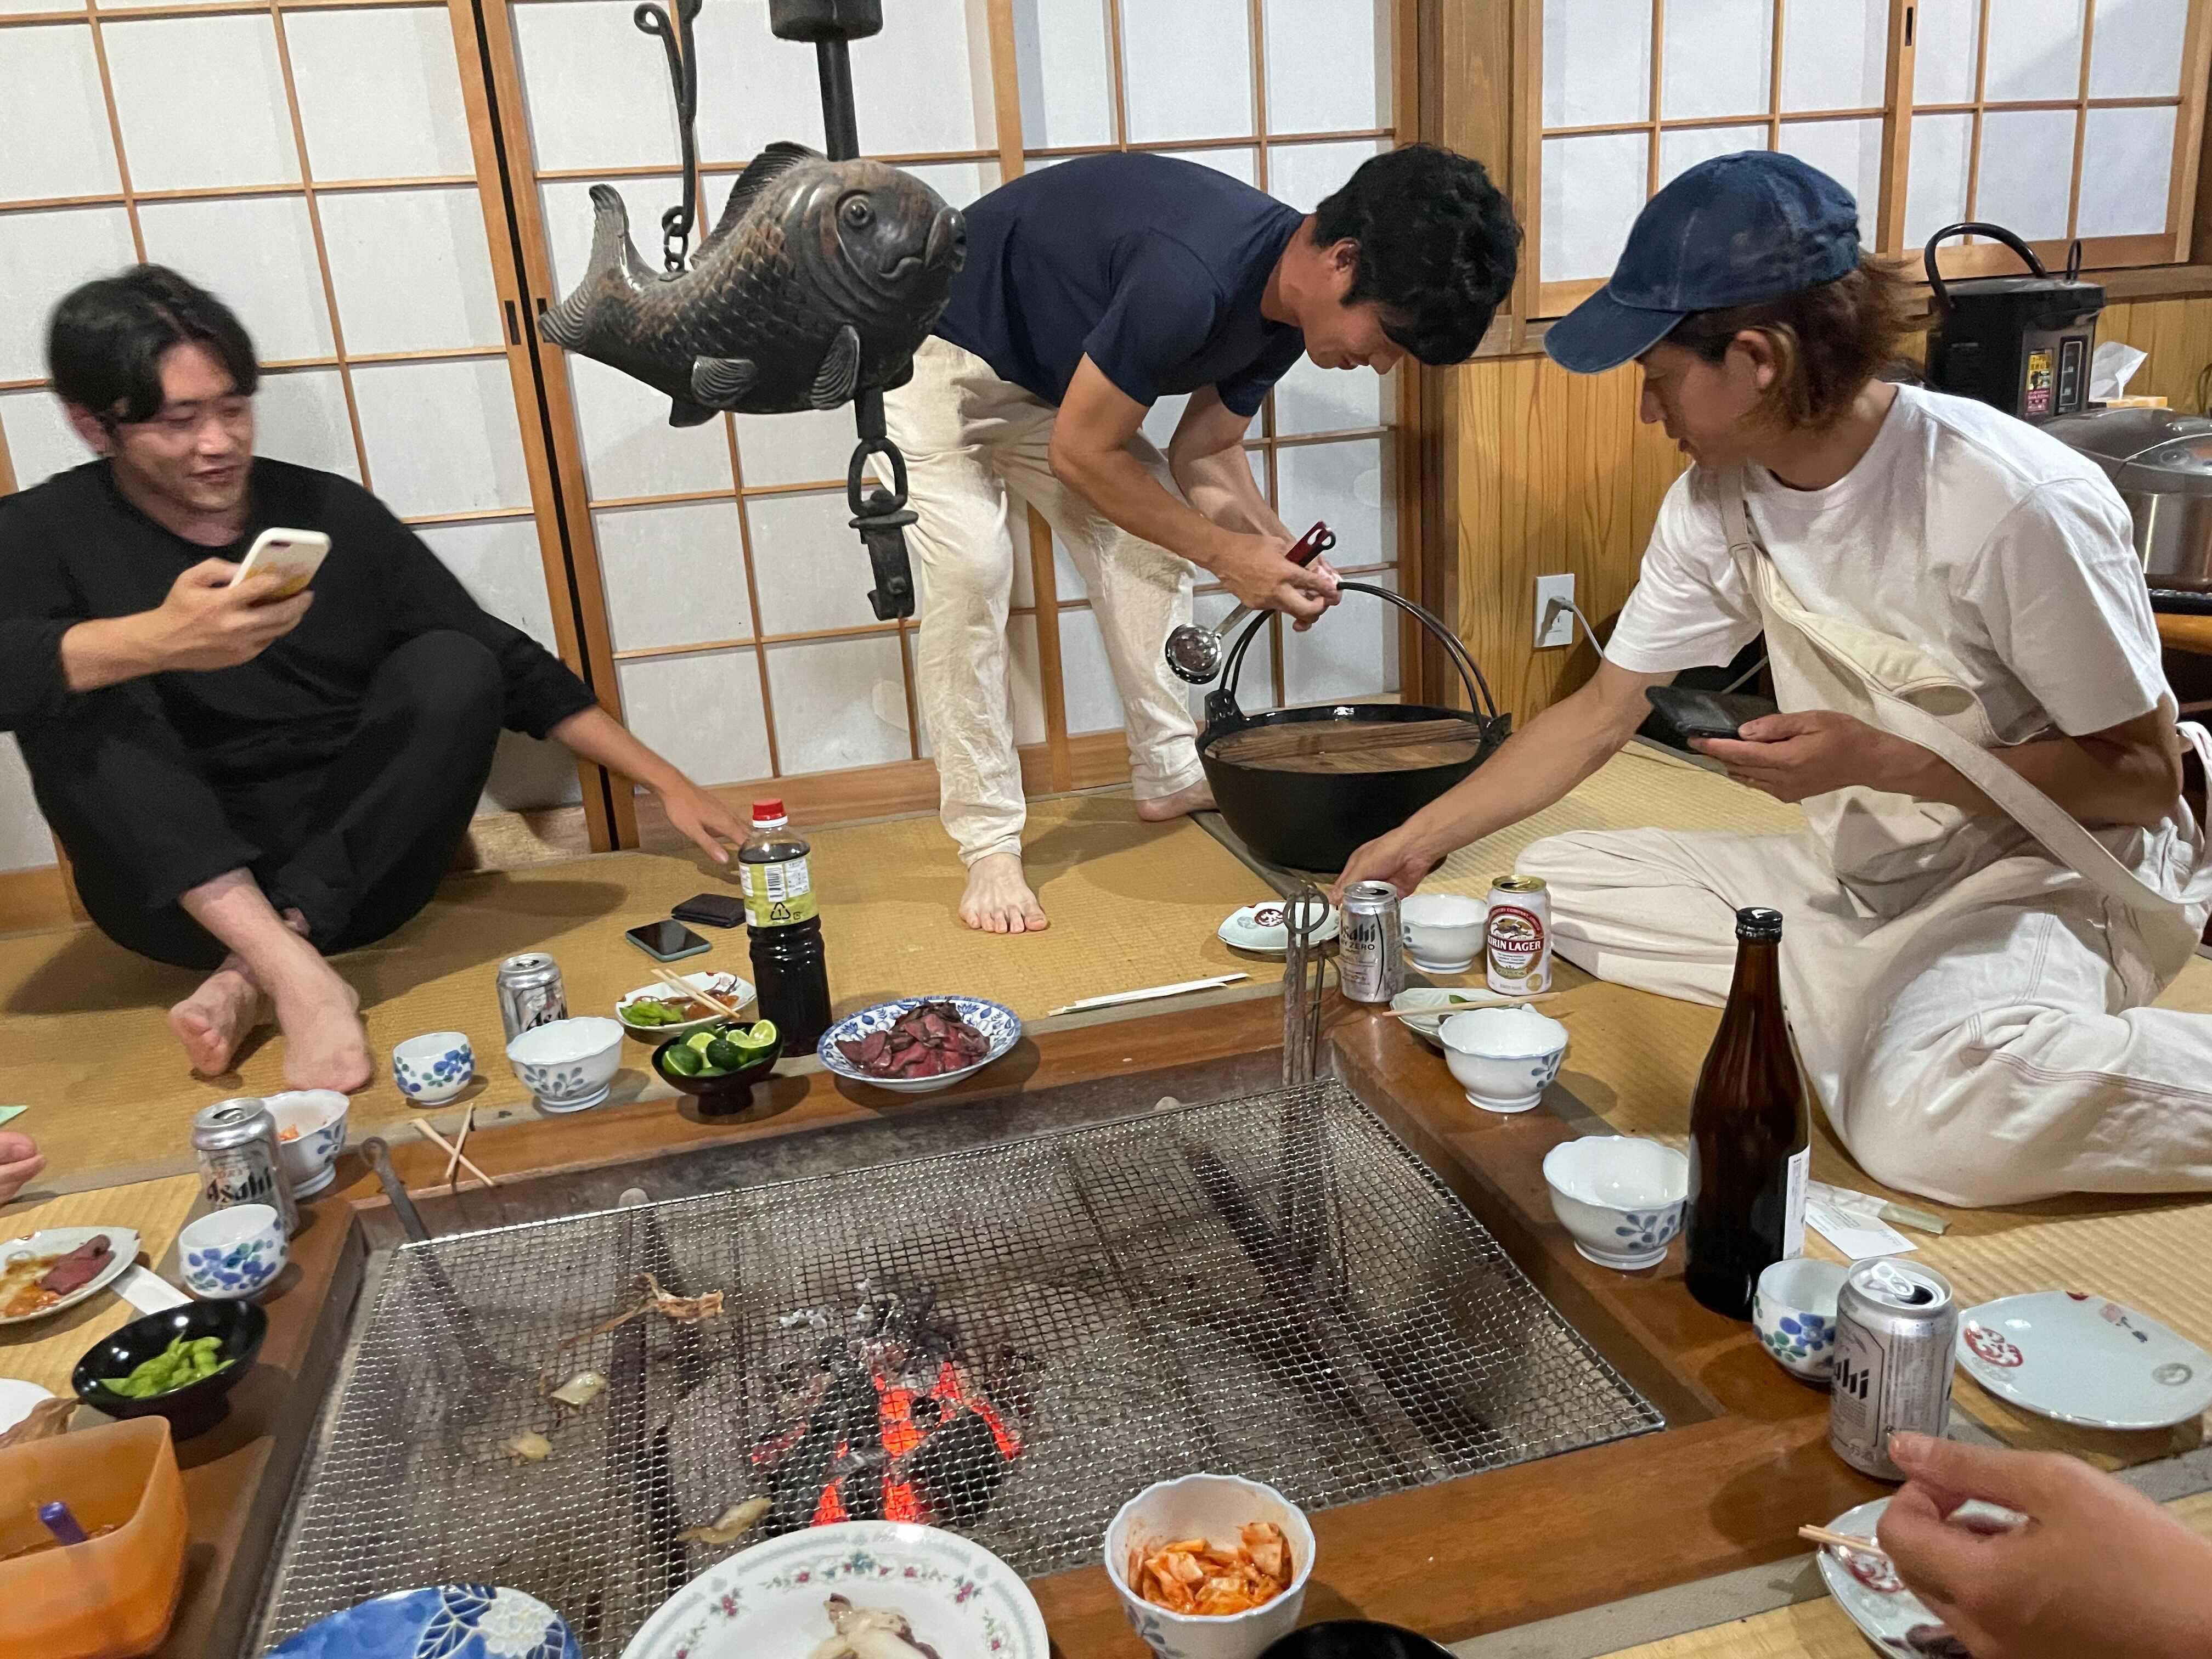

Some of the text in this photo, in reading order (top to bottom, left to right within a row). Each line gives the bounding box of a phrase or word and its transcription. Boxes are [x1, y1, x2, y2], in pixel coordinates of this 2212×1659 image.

[1349, 942, 1375, 951] ZERO
[1509, 940, 1541, 951] LAGER
[206, 1166, 272, 1203] Asahi
